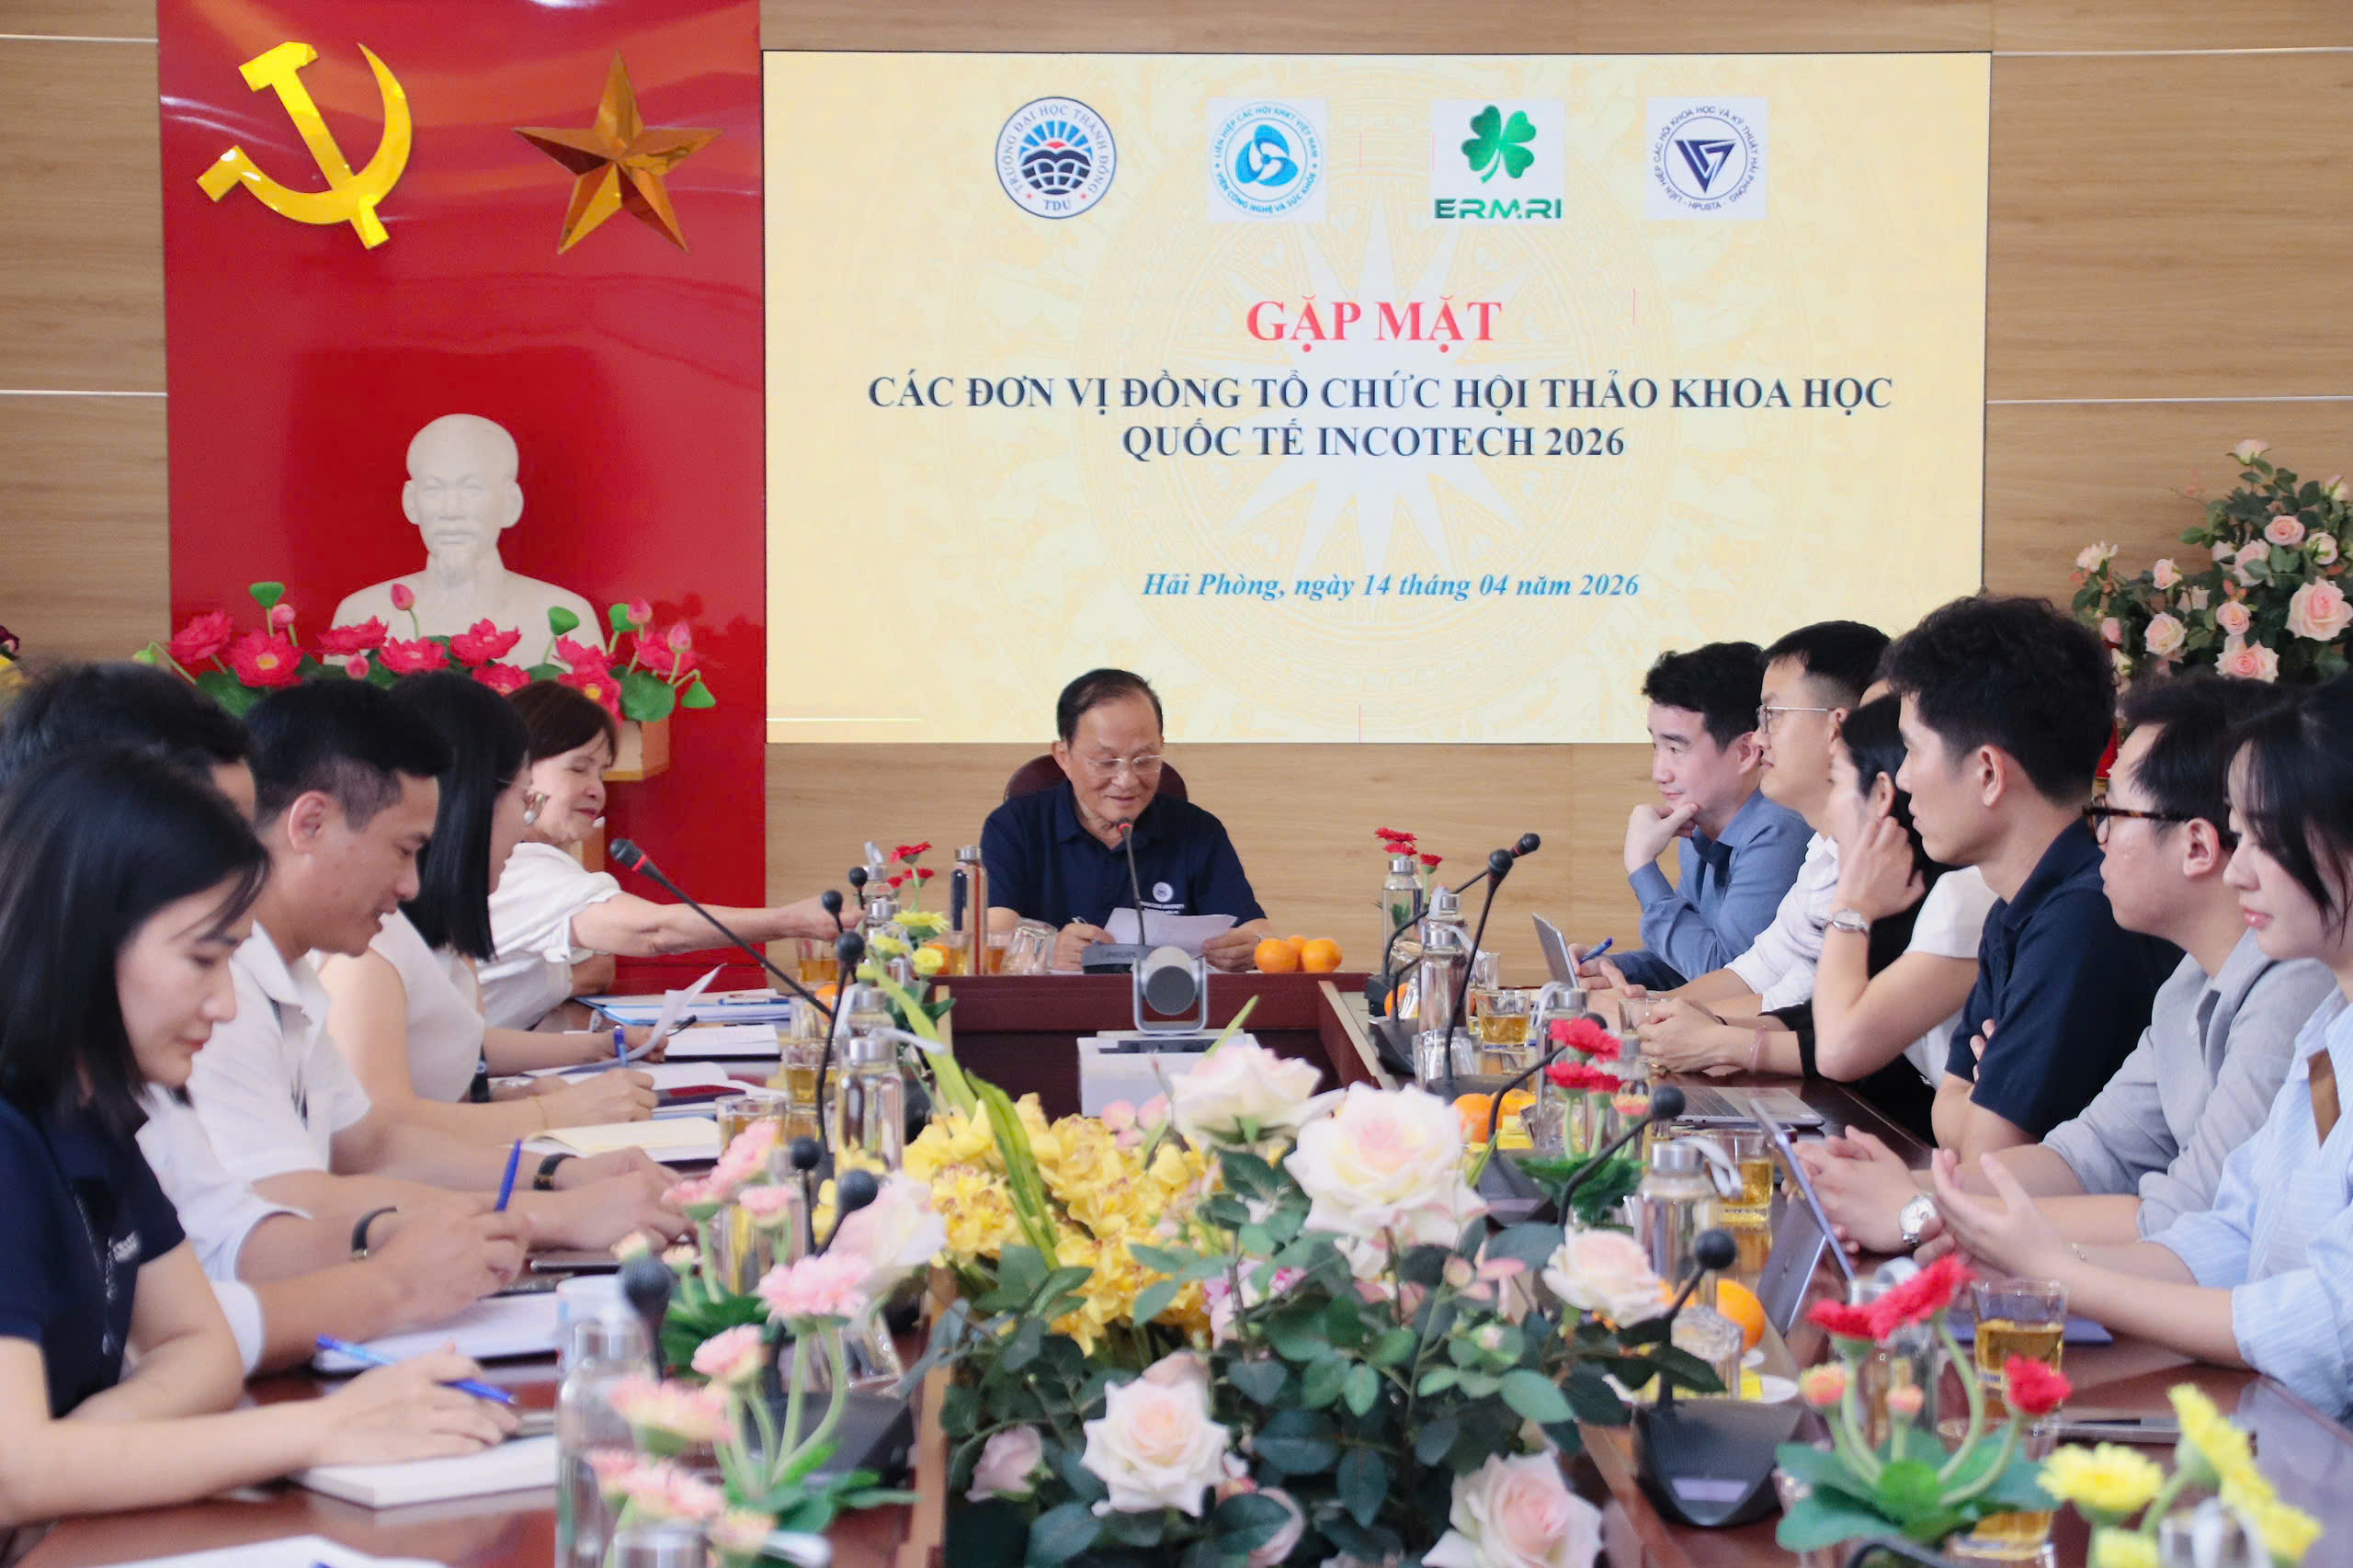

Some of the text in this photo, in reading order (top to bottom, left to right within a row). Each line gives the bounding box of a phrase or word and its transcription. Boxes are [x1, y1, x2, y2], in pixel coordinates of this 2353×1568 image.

[1044, 199, 1072, 211] TDU
[1434, 198, 1563, 220] ERM.RI
[1246, 295, 1502, 354] GẶP MẶT
[869, 369, 1893, 415] CÁC ĐƠN VỊ ĐỒNG TỔ CHỨC HỘI THẢO KHOA HỌC
[1122, 417, 1625, 462] QUỐC TẾ INCOTECH 2026
[1142, 573, 1640, 601] Hải Phòng, ngày 14 tháng 04 năm 2026
